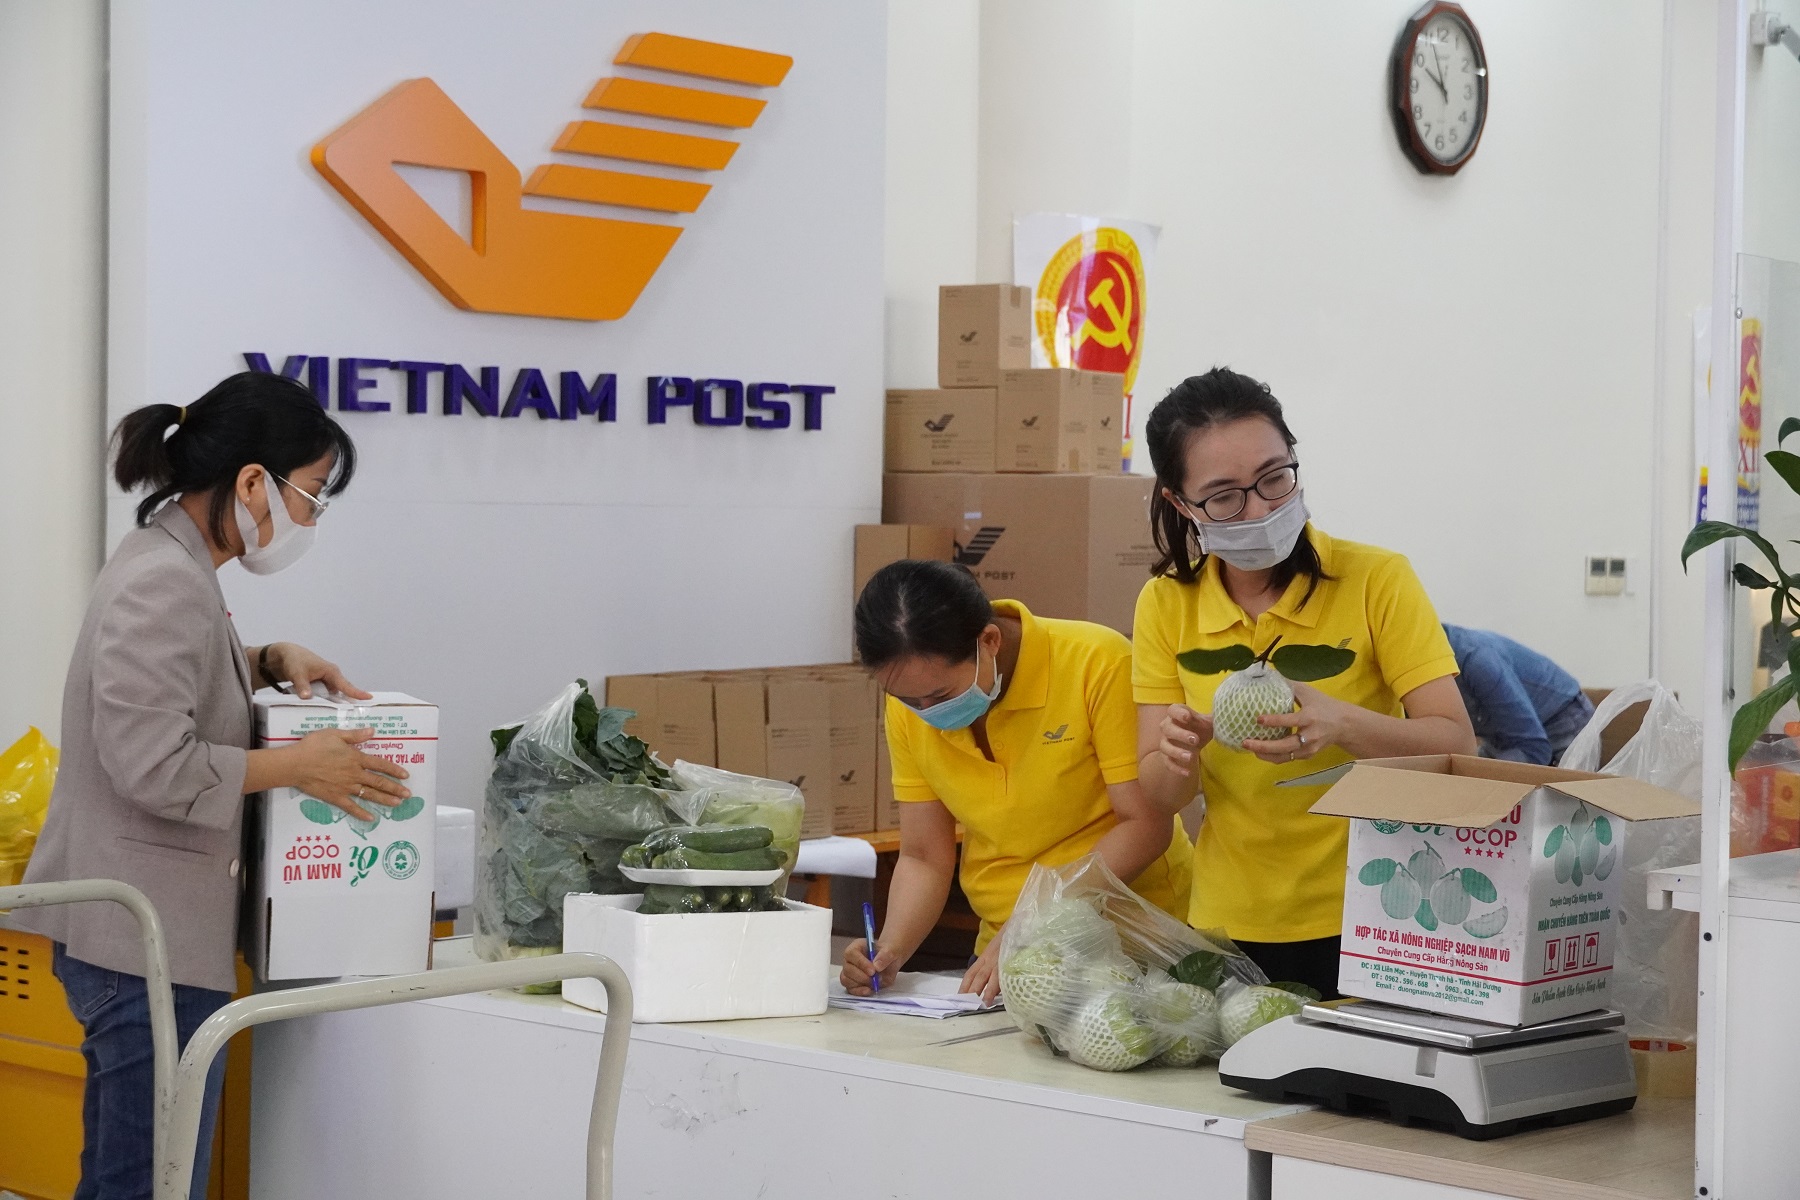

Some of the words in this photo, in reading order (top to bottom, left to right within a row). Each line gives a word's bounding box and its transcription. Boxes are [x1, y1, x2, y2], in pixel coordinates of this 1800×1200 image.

[1437, 27, 1449, 43] 12
[1461, 58, 1470, 73] 2
[1410, 79, 1418, 94] 9
[1464, 85, 1473, 101] 3
[1414, 105, 1422, 120] 8
[1458, 111, 1467, 123] 4
[1424, 123, 1431, 139] 7
[1450, 129, 1457, 144] 5
[1435, 135, 1444, 151] 6
[647, 376, 836, 431] POST
[984, 571, 1015, 580] POST
[410, 752, 424, 764] HỢP
[1455, 828, 1518, 848] OCOP
[285, 844, 340, 860] OCOP
[283, 865, 302, 884] VŨ
[307, 863, 342, 880] NAM
[1355, 925, 1370, 940] HỢP
[1373, 926, 1387, 942] TÁC
[1388, 930, 1399, 944] XÃ
[1401, 932, 1423, 948] NÔNG
[1425, 937, 1454, 954] NGHIỆP
[1456, 942, 1476, 957] SẠCH
[1478, 946, 1498, 960] NAM
[1500, 948, 1510, 962] VŨ
[1378, 946, 1402, 958] Chuyên
[1404, 950, 1420, 961] Cung
[1456, 959, 1474, 970] Nông
[1382, 965, 1394, 973] Liên
[1394, 968, 1406, 976] Mạc
[1410, 970, 1428, 980] Huyện
